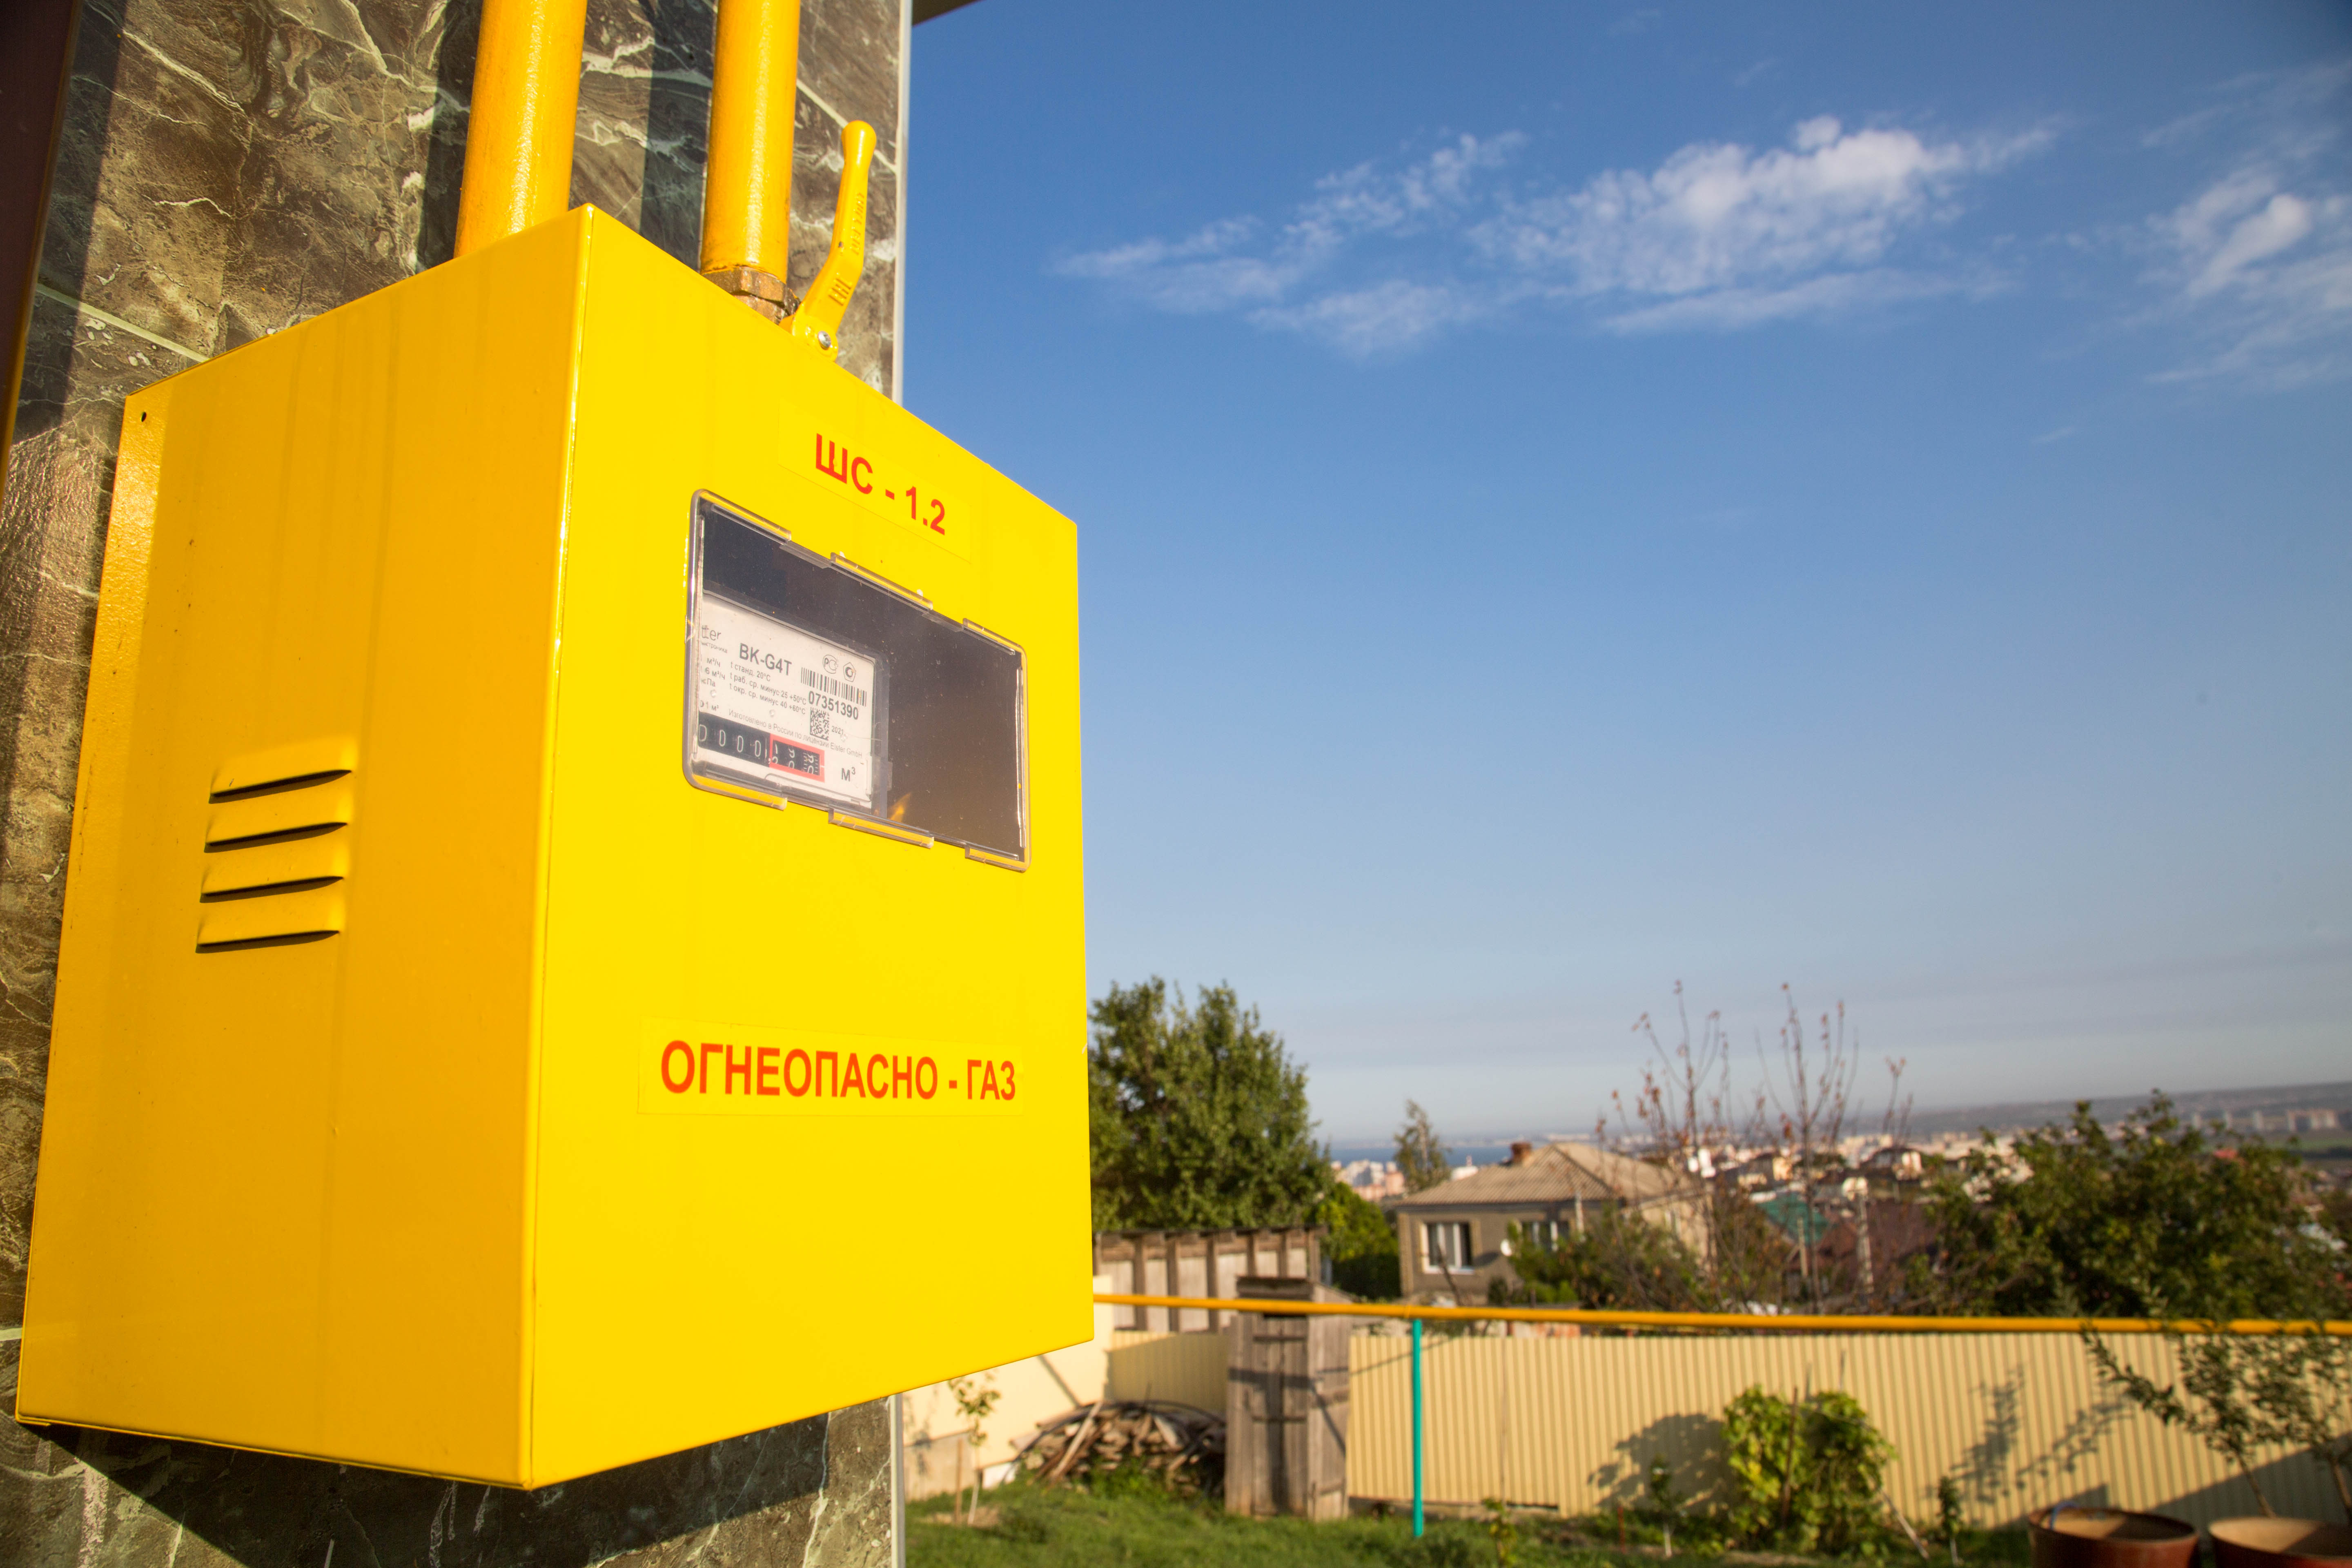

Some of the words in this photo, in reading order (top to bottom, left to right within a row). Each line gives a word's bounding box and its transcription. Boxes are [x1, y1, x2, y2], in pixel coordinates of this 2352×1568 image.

[816, 433, 873, 494] ШС
[906, 486, 945, 536] 1.2
[729, 709, 767, 728] Изготовлено
[773, 723, 794, 737] России
[803, 734, 829, 748] лицензии
[831, 742, 846, 753] Elster
[808, 690, 858, 720] 07351390
[661, 1040, 938, 1100] ОГНЕОПАСНО
[967, 1058, 1016, 1101] ГАЗ
